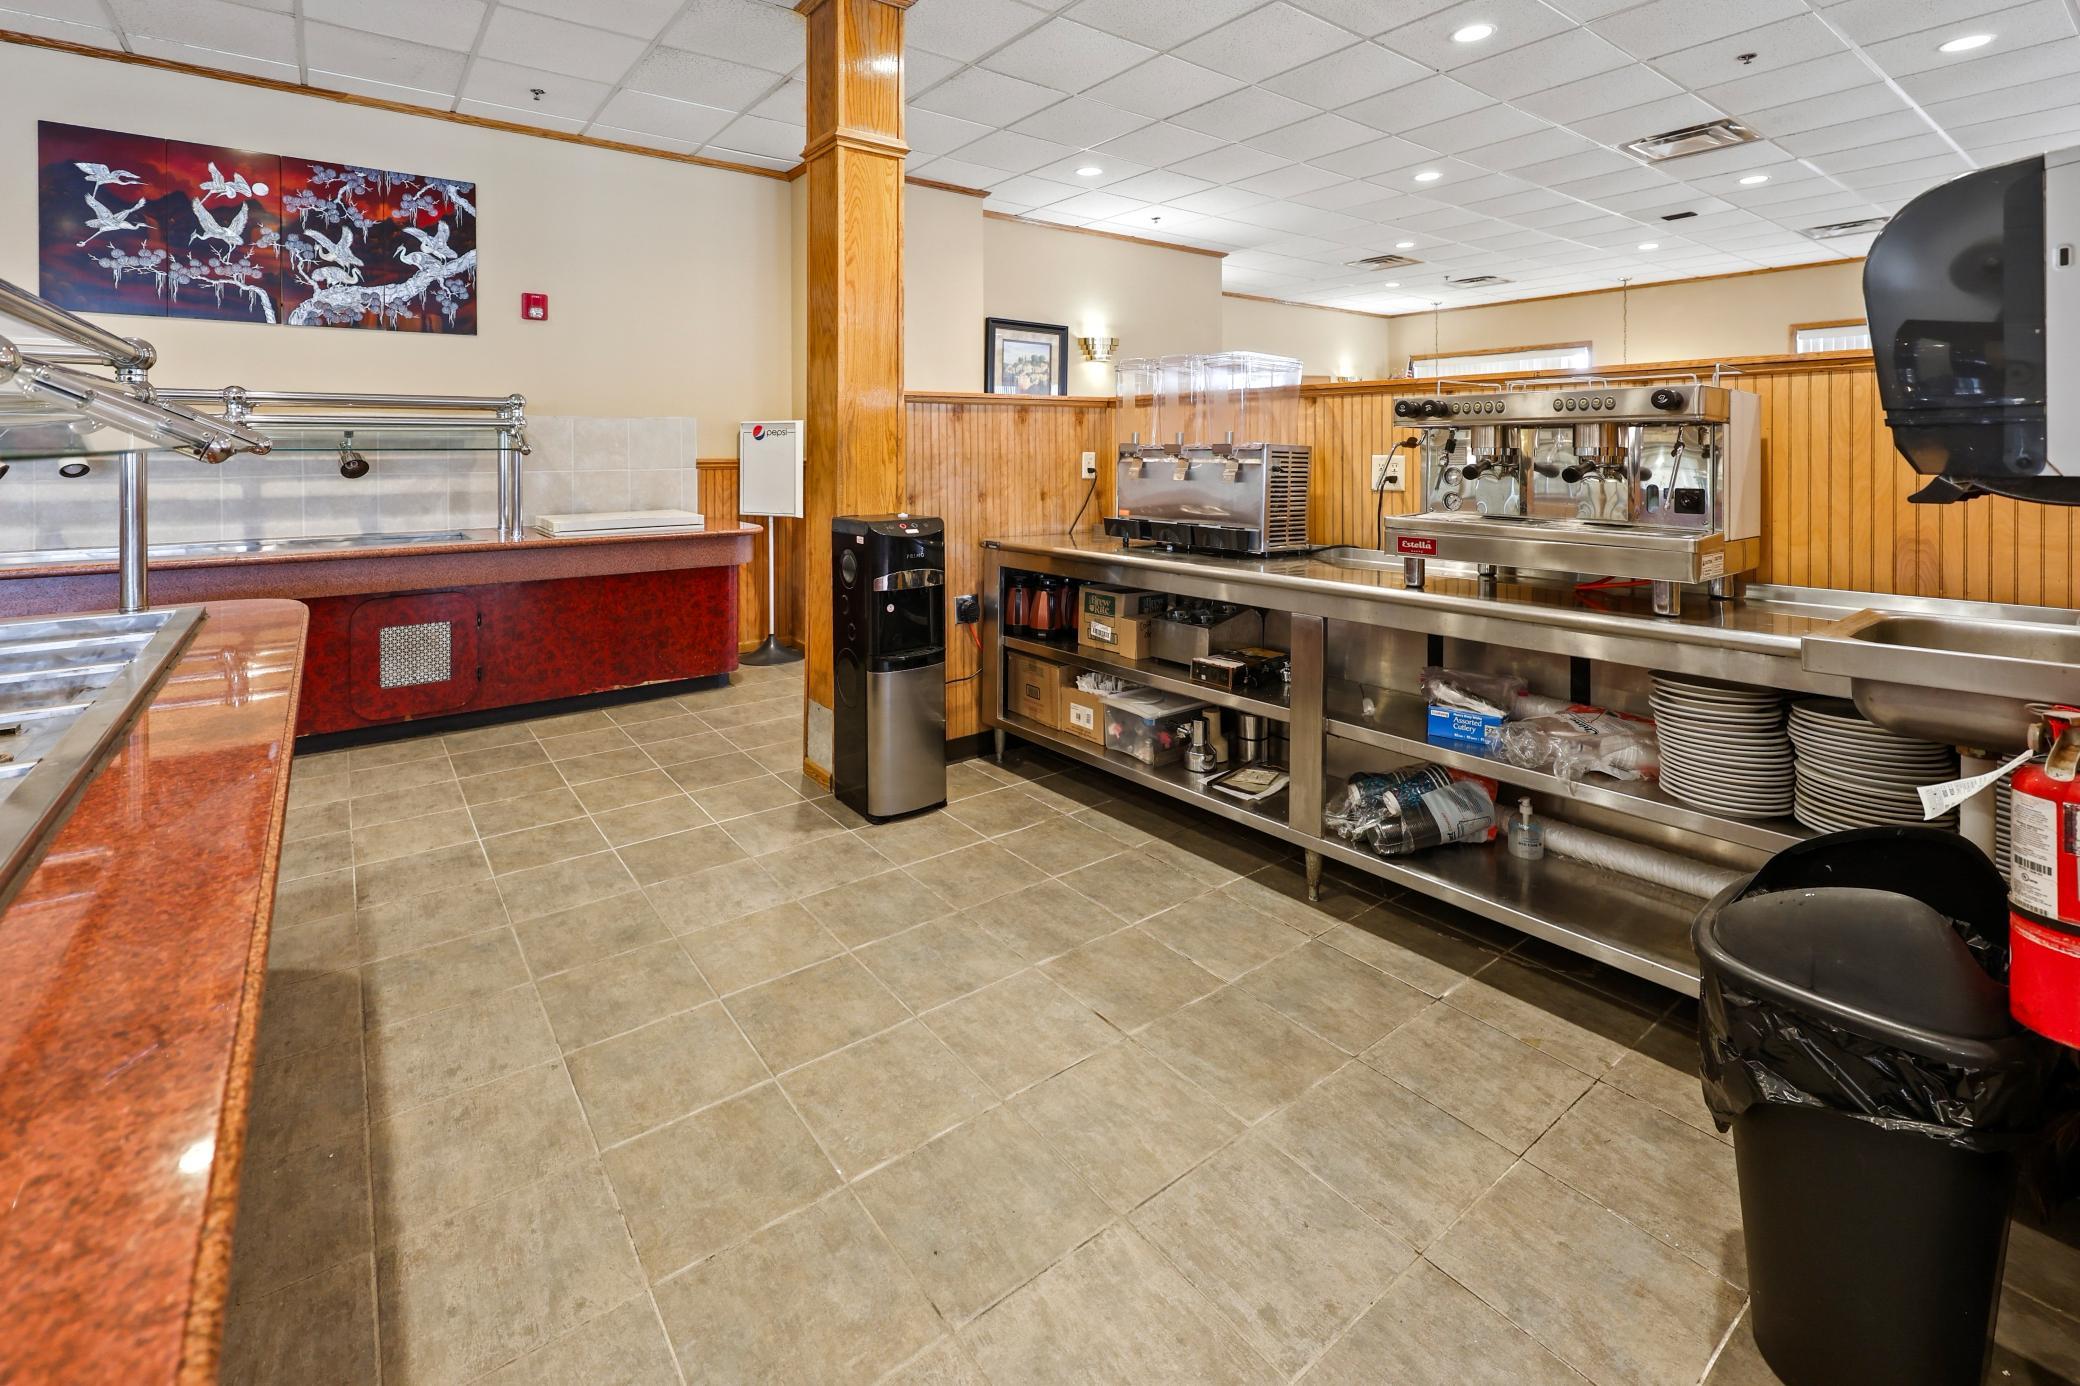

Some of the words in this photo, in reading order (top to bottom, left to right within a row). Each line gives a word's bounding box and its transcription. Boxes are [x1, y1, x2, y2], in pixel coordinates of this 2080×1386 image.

[766, 428, 787, 437] pepsi
[1090, 595, 1111, 606] Brew
[1453, 717, 1482, 727] Assorted
[1453, 723, 1477, 734] Cutlery
